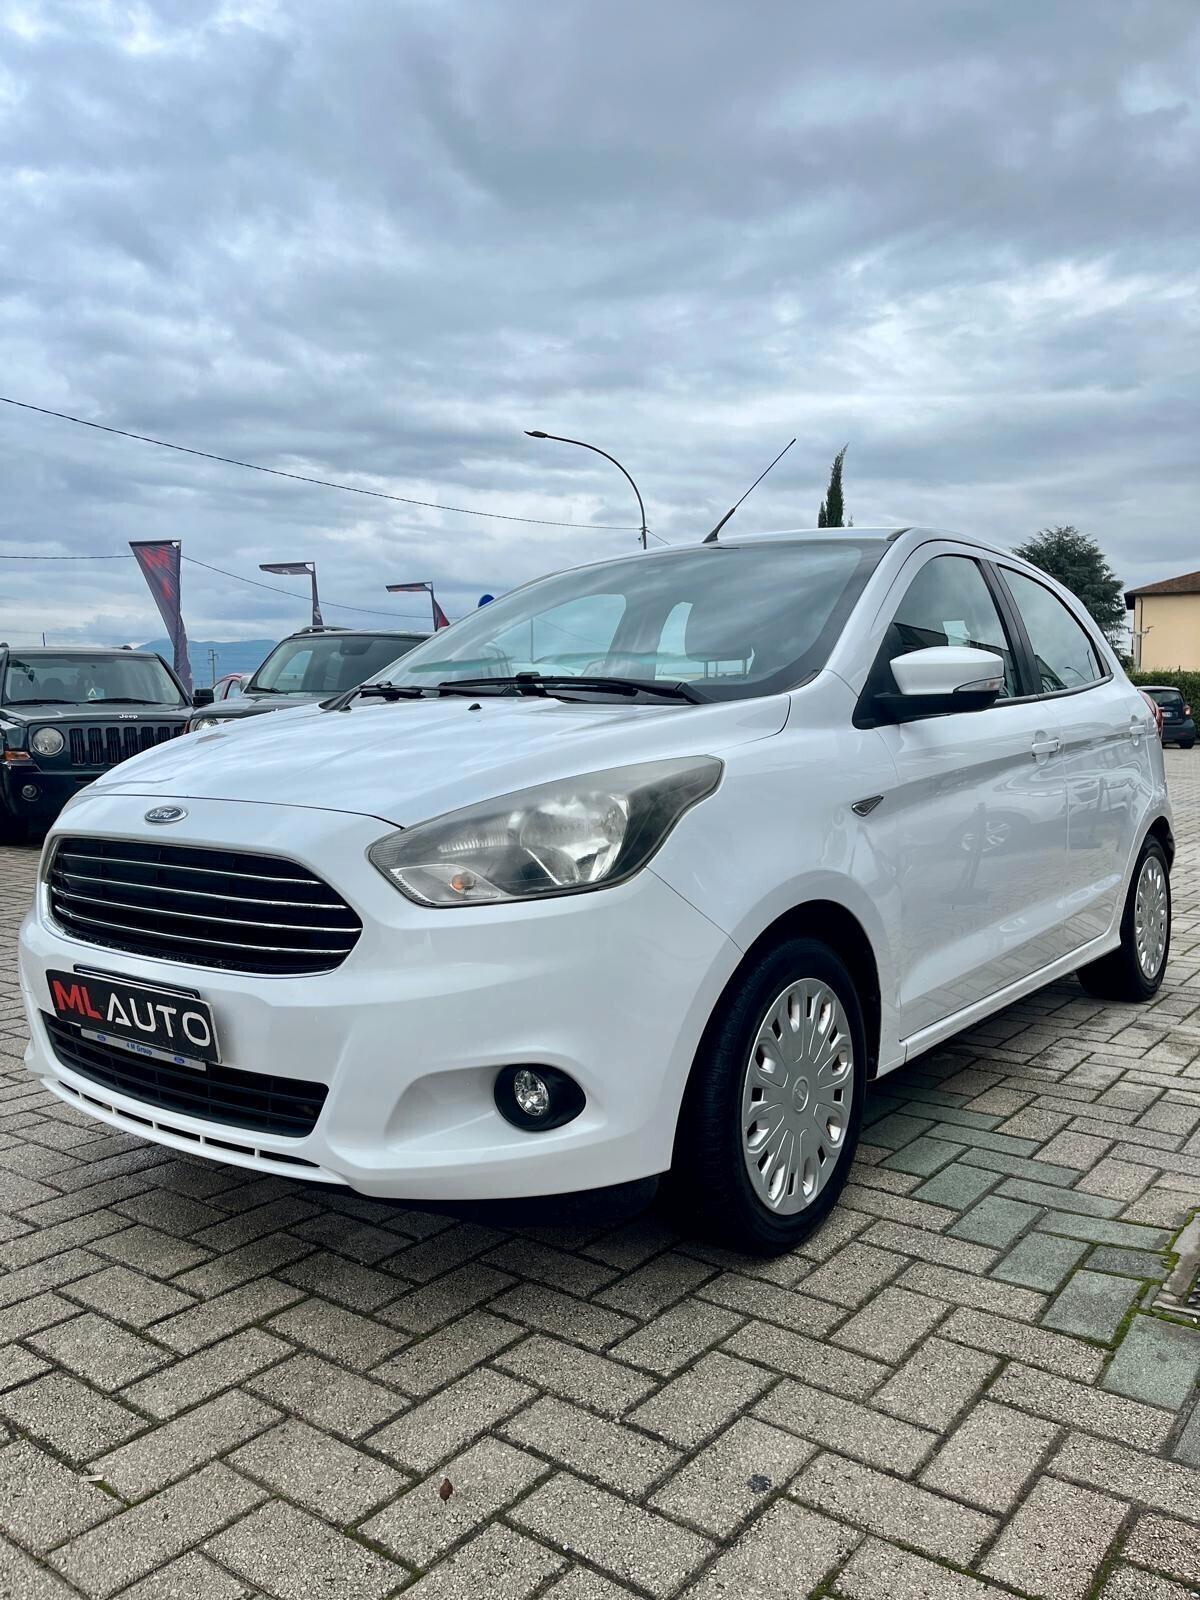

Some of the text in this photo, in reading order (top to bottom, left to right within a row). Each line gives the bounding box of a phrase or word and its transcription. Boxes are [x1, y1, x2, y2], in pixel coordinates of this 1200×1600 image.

[149, 807, 177, 819] Ford
[52, 980, 211, 1047] ML AUTO
